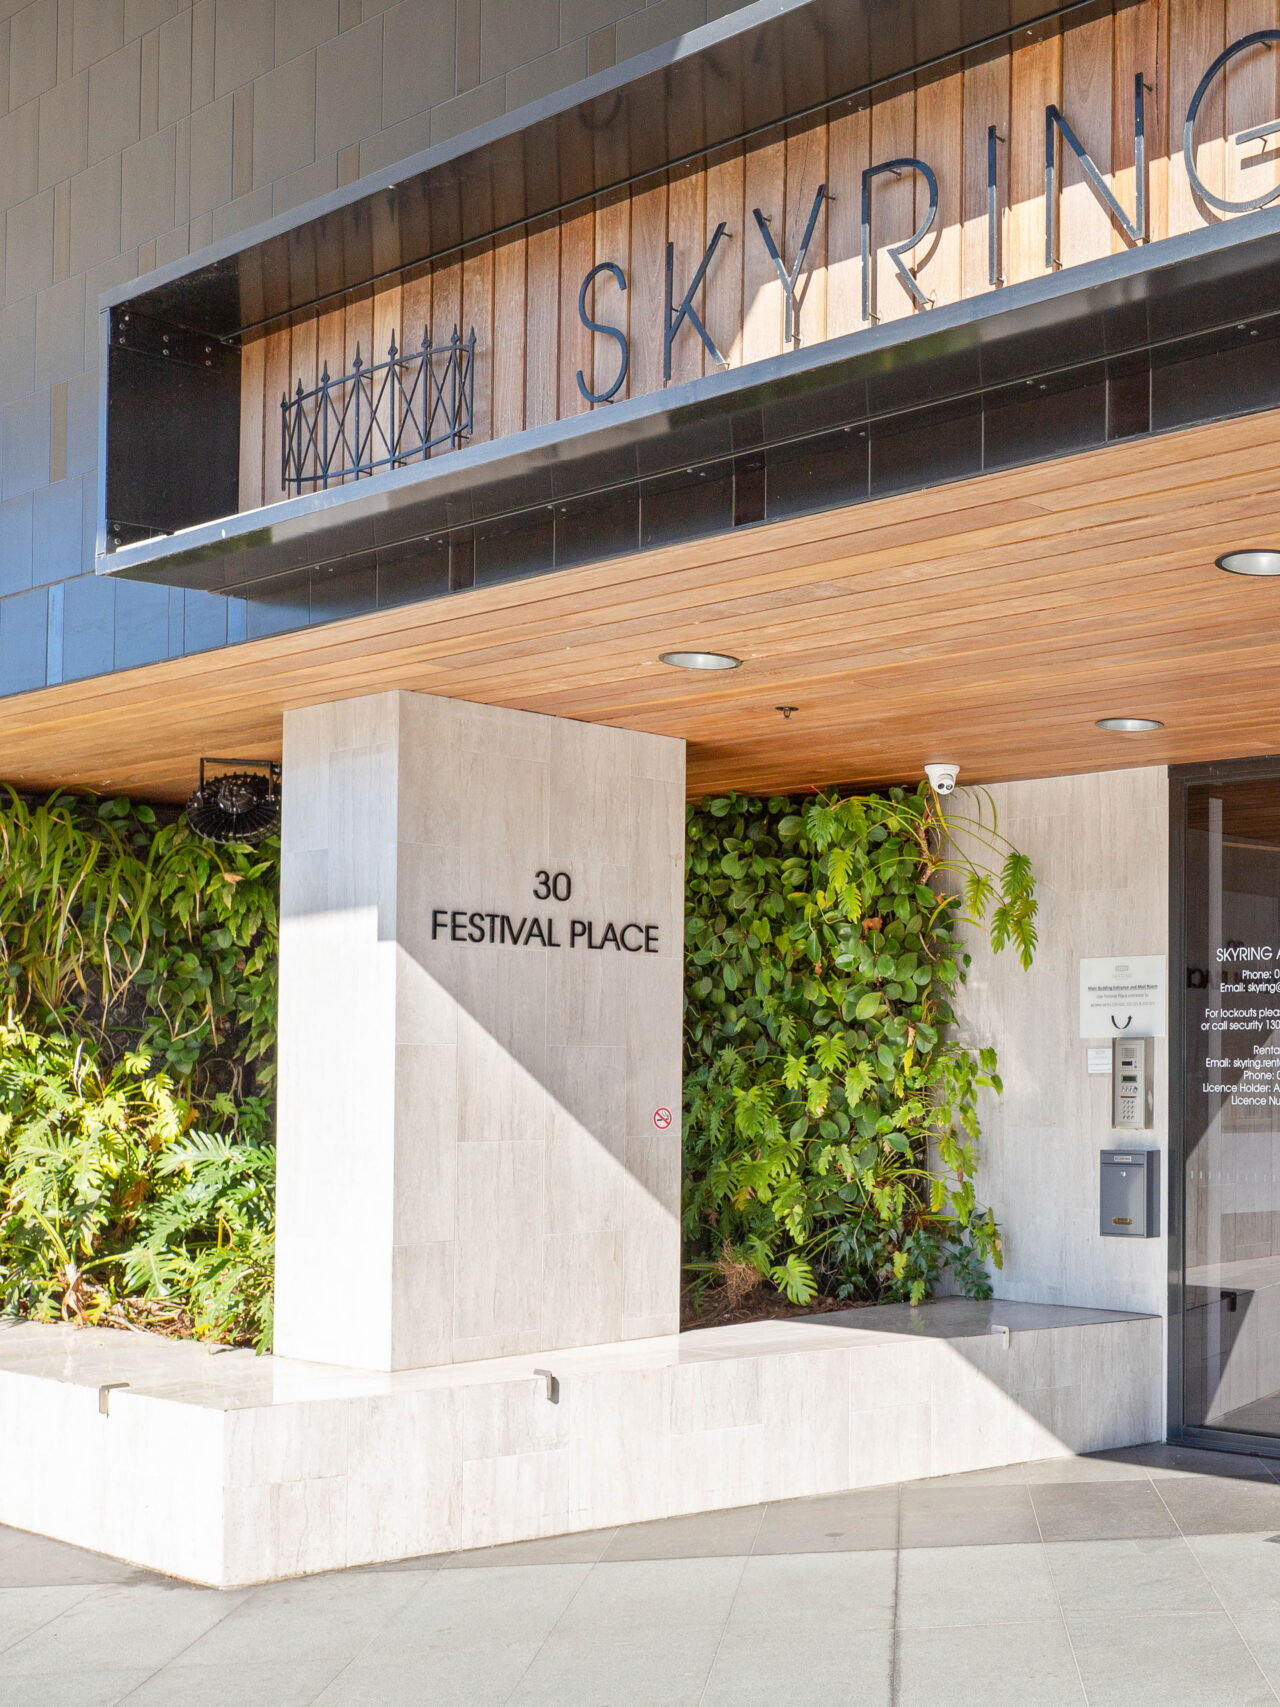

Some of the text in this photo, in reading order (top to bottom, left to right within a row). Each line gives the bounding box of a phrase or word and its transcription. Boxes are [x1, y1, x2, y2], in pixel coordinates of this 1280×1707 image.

[533, 870, 572, 901] 30
[431, 909, 659, 953] FESTIVAL PLACE
[1216, 946, 1273, 962] SKYRING
[1242, 969, 1272, 979] Phone:
[1220, 982, 1246, 993] Email:
[1205, 1008, 1219, 1018] For
[1220, 1007, 1257, 1018] lockouts
[1201, 1022, 1210, 1031] or
[1211, 1020, 1228, 1030] call
[1229, 1020, 1263, 1032] security
[1206, 1058, 1231, 1068] Email:
[1243, 1071, 1275, 1080] Phone:
[1202, 1083, 1238, 1093] Licence
[1240, 1083, 1271, 1093] Holder:
[1231, 1095, 1267, 1105] Licence
